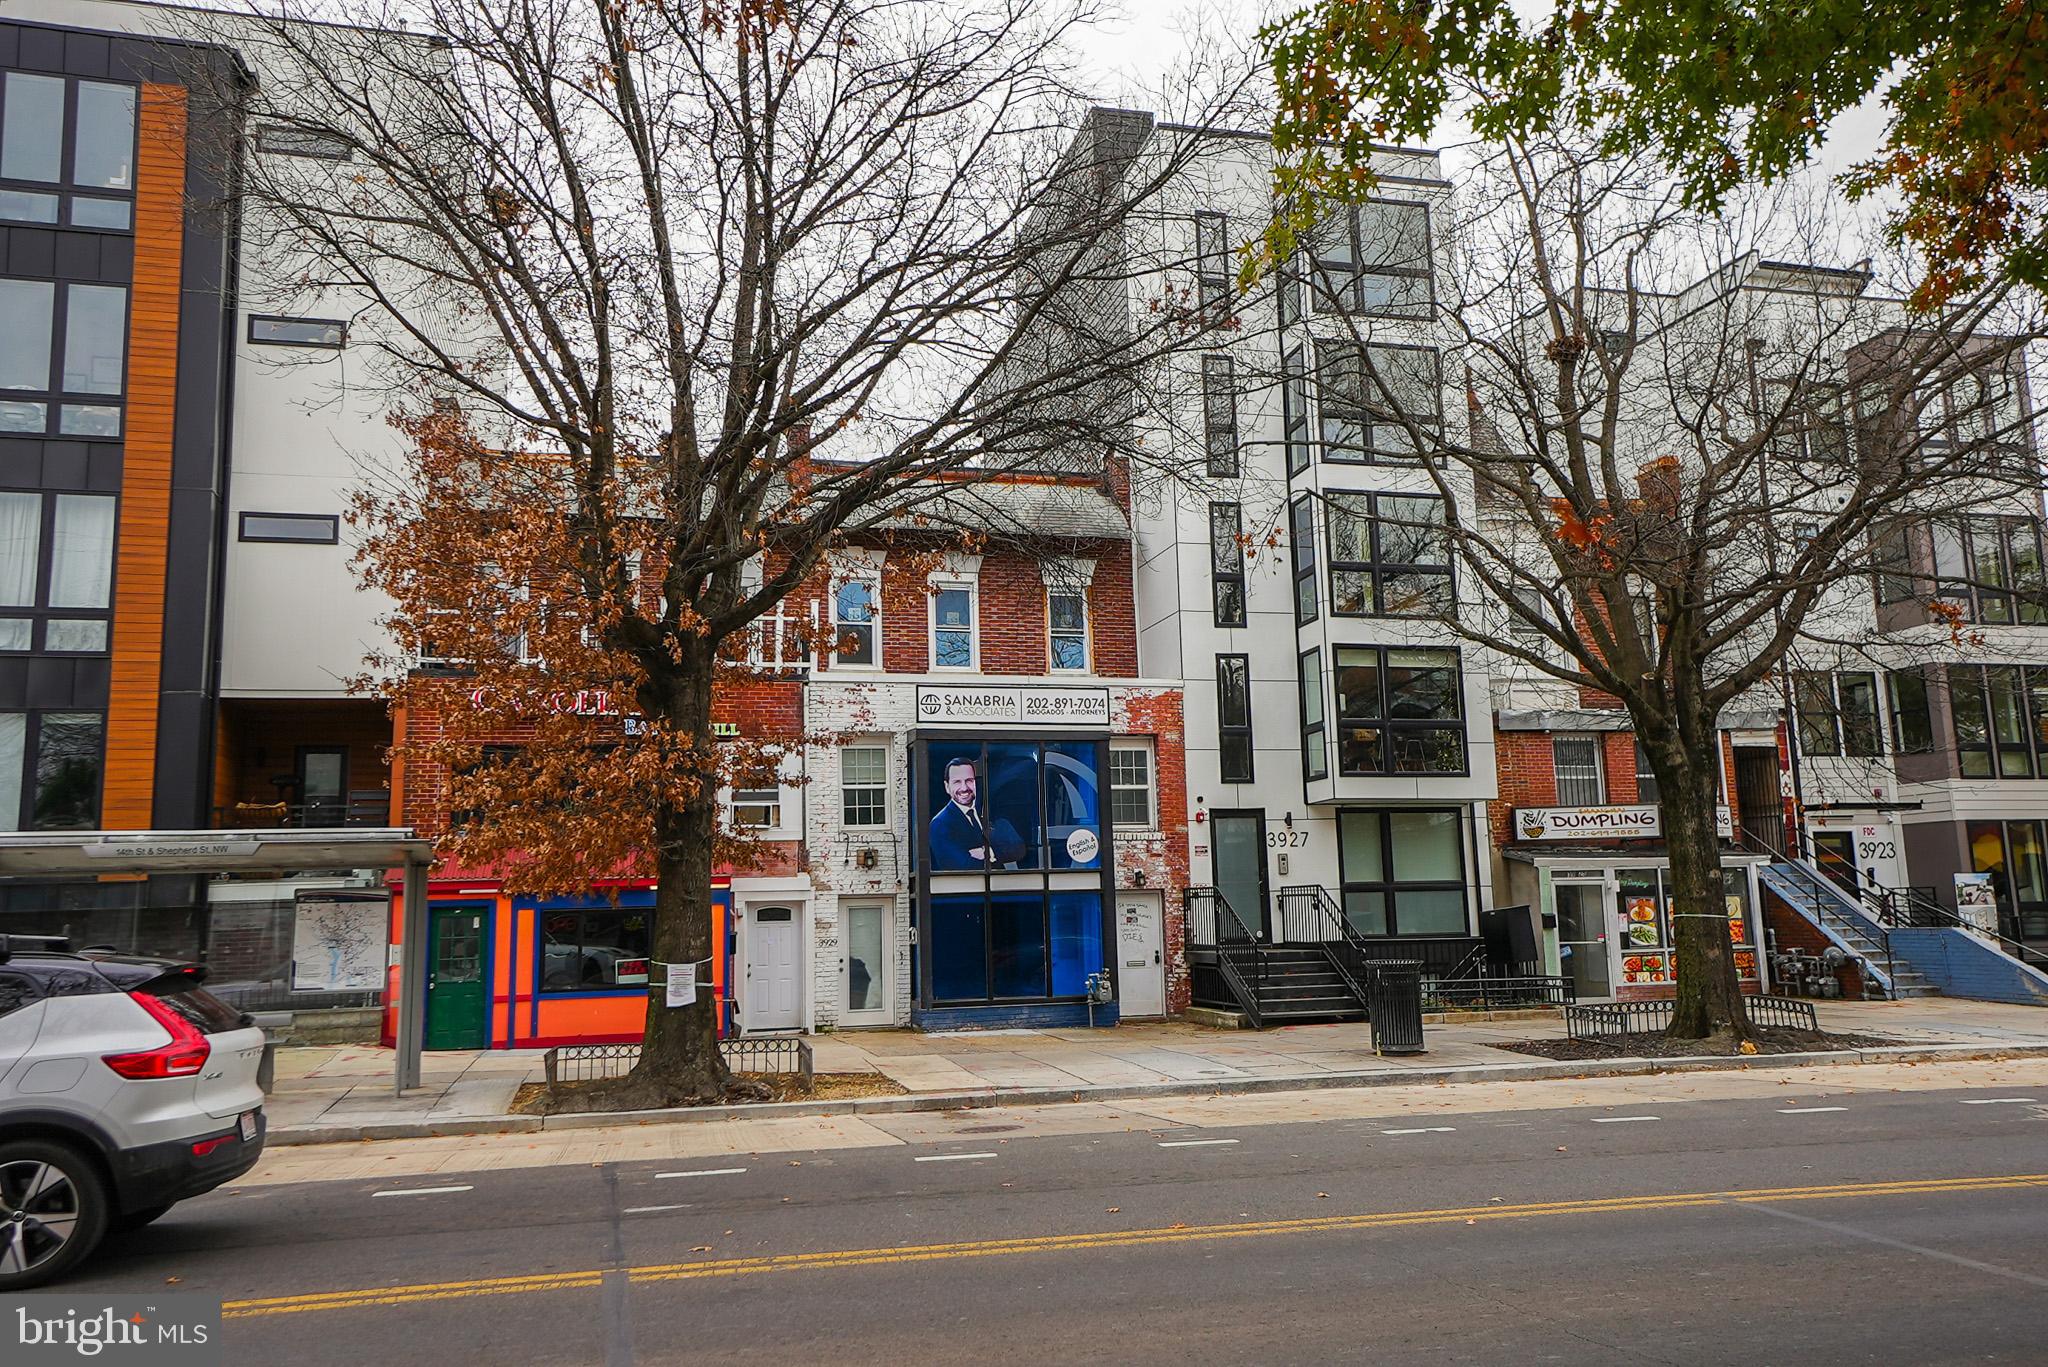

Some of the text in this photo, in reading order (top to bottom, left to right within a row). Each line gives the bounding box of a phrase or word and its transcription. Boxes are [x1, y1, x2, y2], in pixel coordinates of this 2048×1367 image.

[944, 694, 1016, 707] SANABRIA
[1026, 697, 1106, 709] 202-891-7074
[945, 706, 1016, 717] & ASSOCIATES
[1026, 708, 1064, 716] ABOGADOS
[1550, 812, 1655, 828] DUMPLING
[1862, 827, 1875, 836] FDC
[1267, 831, 1309, 848] 3927
[116, 847, 134, 856] 14th
[147, 847, 154, 856] &
[156, 845, 198, 856] Shepherd
[213, 845, 229, 853] NW
[1859, 842, 1896, 859] 3923
